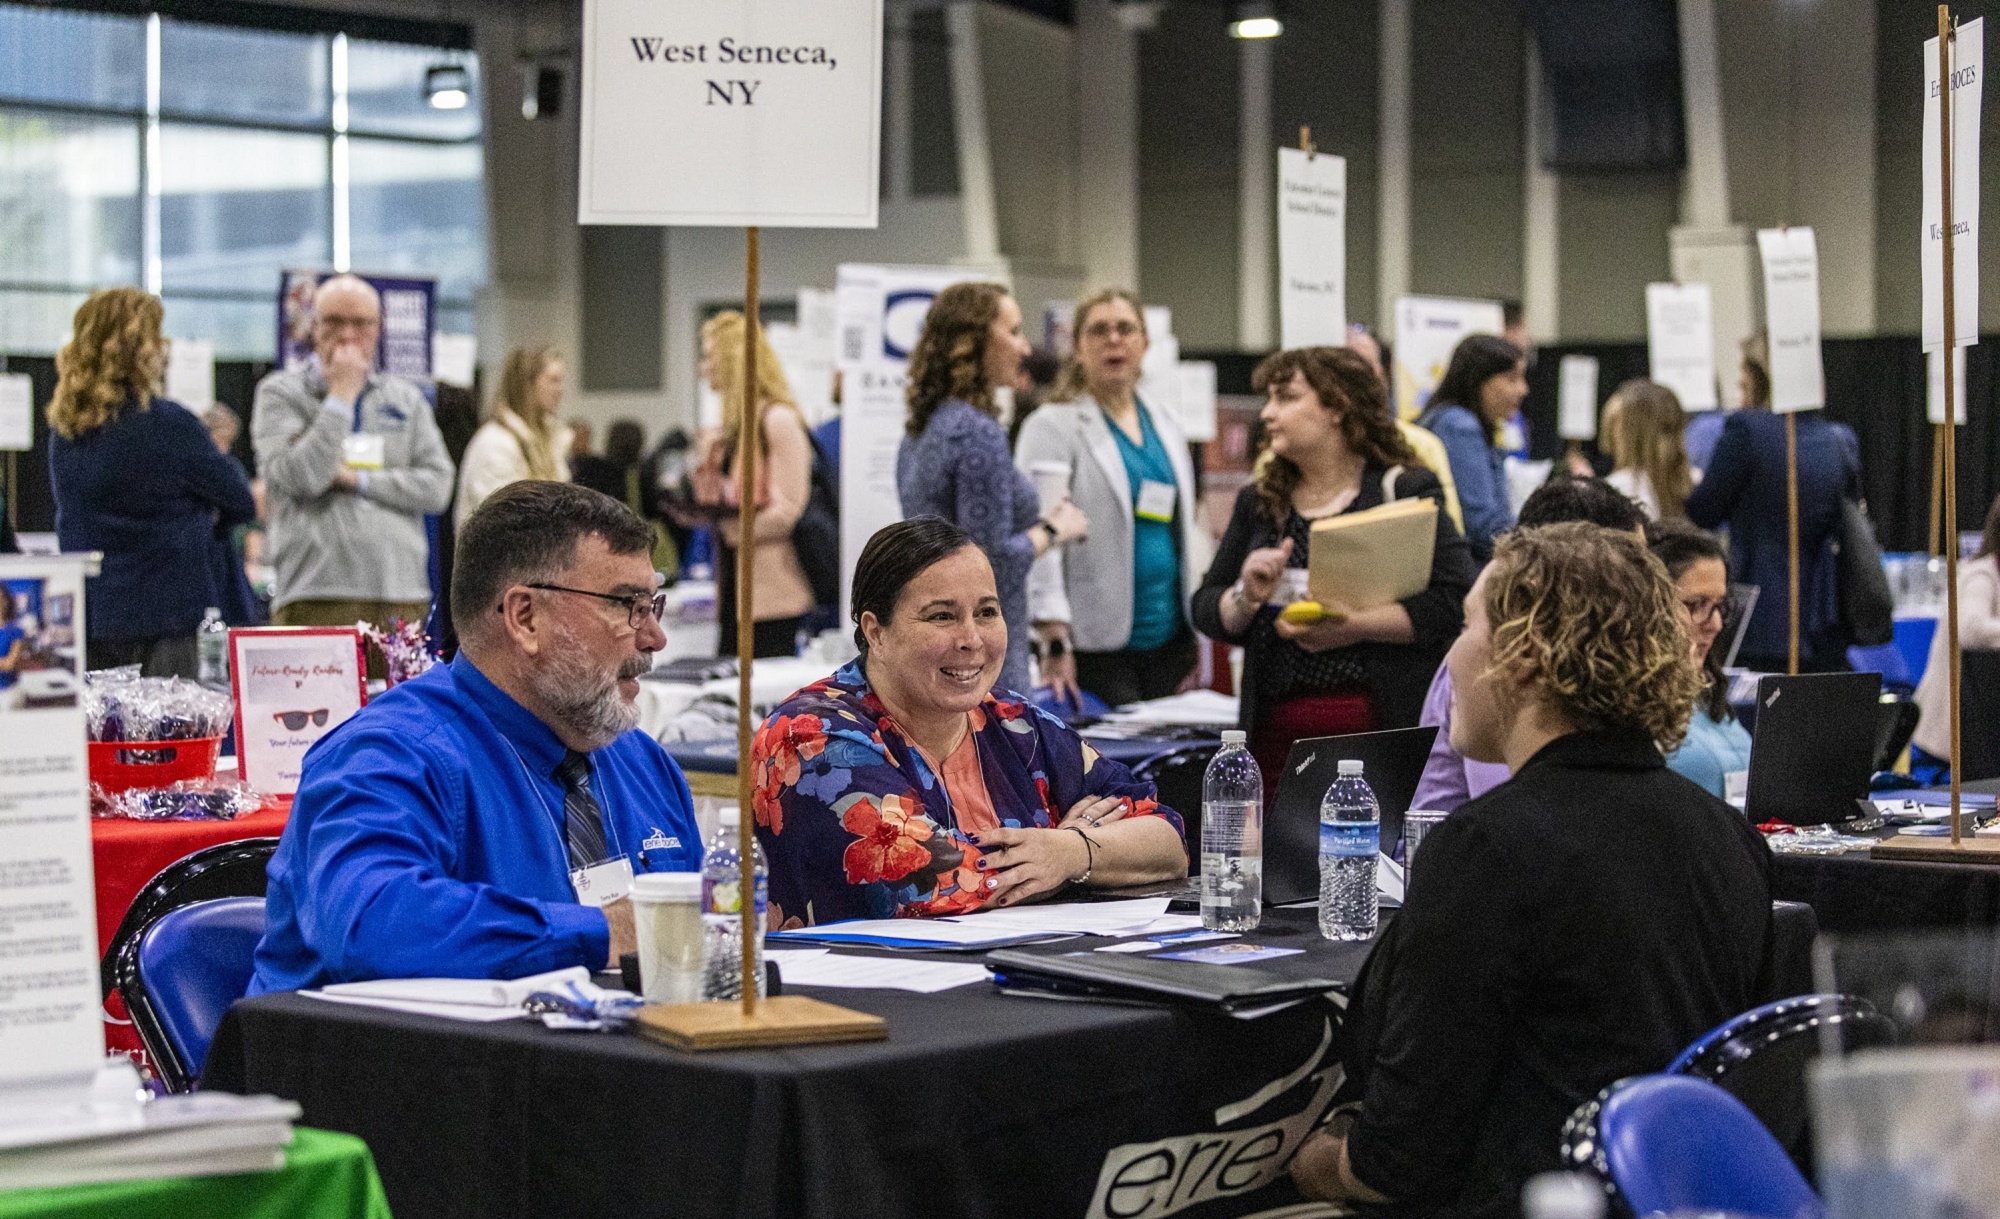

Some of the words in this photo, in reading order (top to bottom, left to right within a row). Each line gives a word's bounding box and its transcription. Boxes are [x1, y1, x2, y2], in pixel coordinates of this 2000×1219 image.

[629, 36, 707, 64] West
[717, 36, 838, 71] Seneca,
[1950, 64, 1976, 91] BOCES
[705, 80, 761, 106] NY
